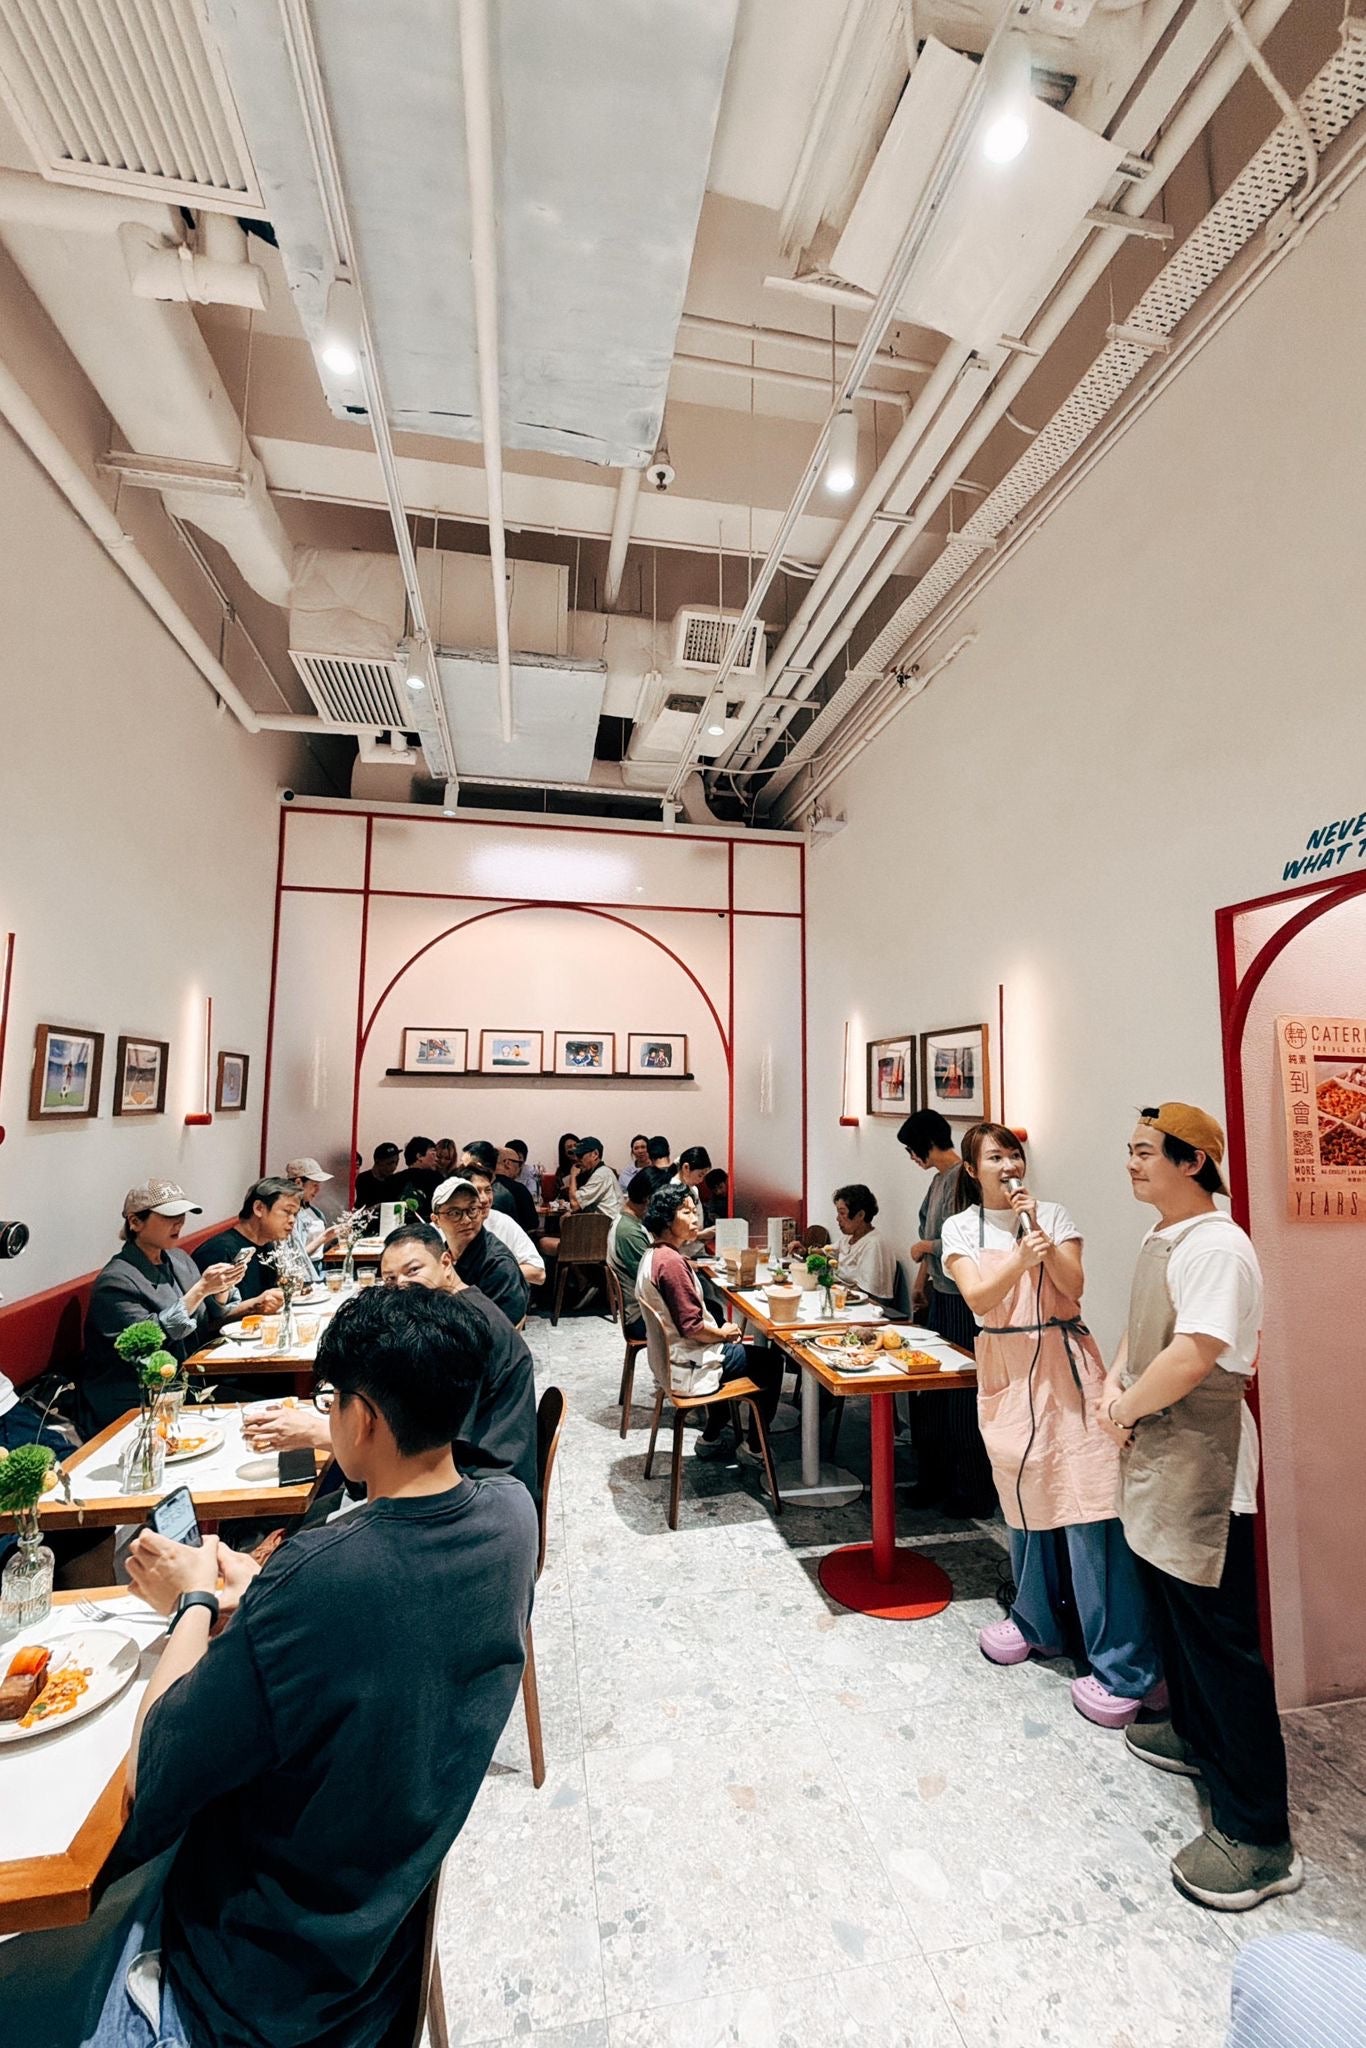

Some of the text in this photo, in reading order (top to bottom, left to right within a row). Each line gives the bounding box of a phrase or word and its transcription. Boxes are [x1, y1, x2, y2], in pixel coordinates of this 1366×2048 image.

[1306, 812, 1366, 850] NEVE
[1283, 842, 1353, 881] WHAT
[1294, 1165, 1316, 1176] MORE
[1296, 1191, 1358, 1217] YEARS
